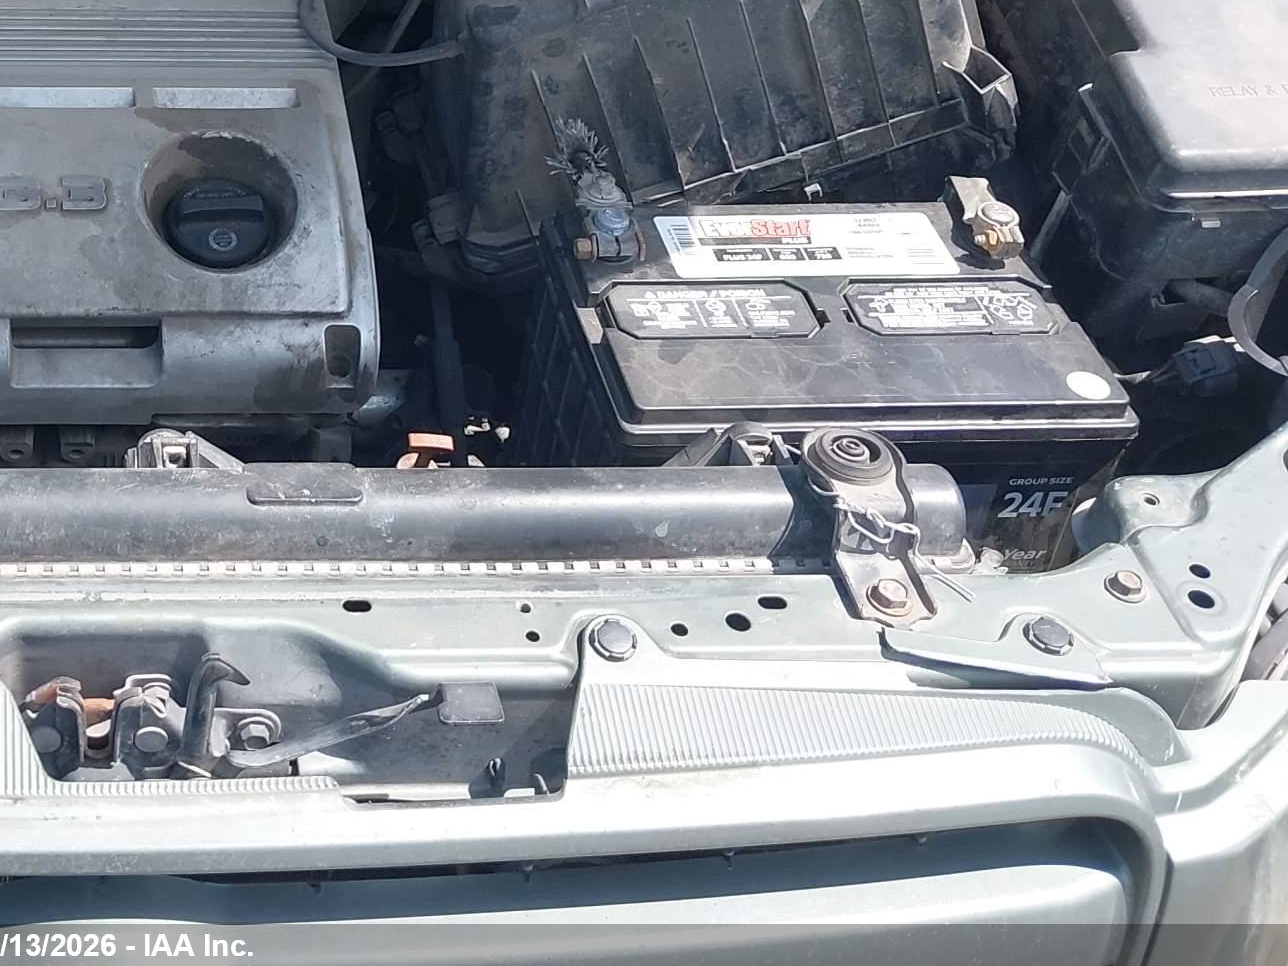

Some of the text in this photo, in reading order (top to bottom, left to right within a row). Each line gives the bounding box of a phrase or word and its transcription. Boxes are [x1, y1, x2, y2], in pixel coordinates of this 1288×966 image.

[1208, 83, 1258, 98] RELAY
[1008, 477, 1074, 486] GROUP SIZE
[996, 491, 1069, 518] 24F
[1002, 548, 1047, 560] Year
